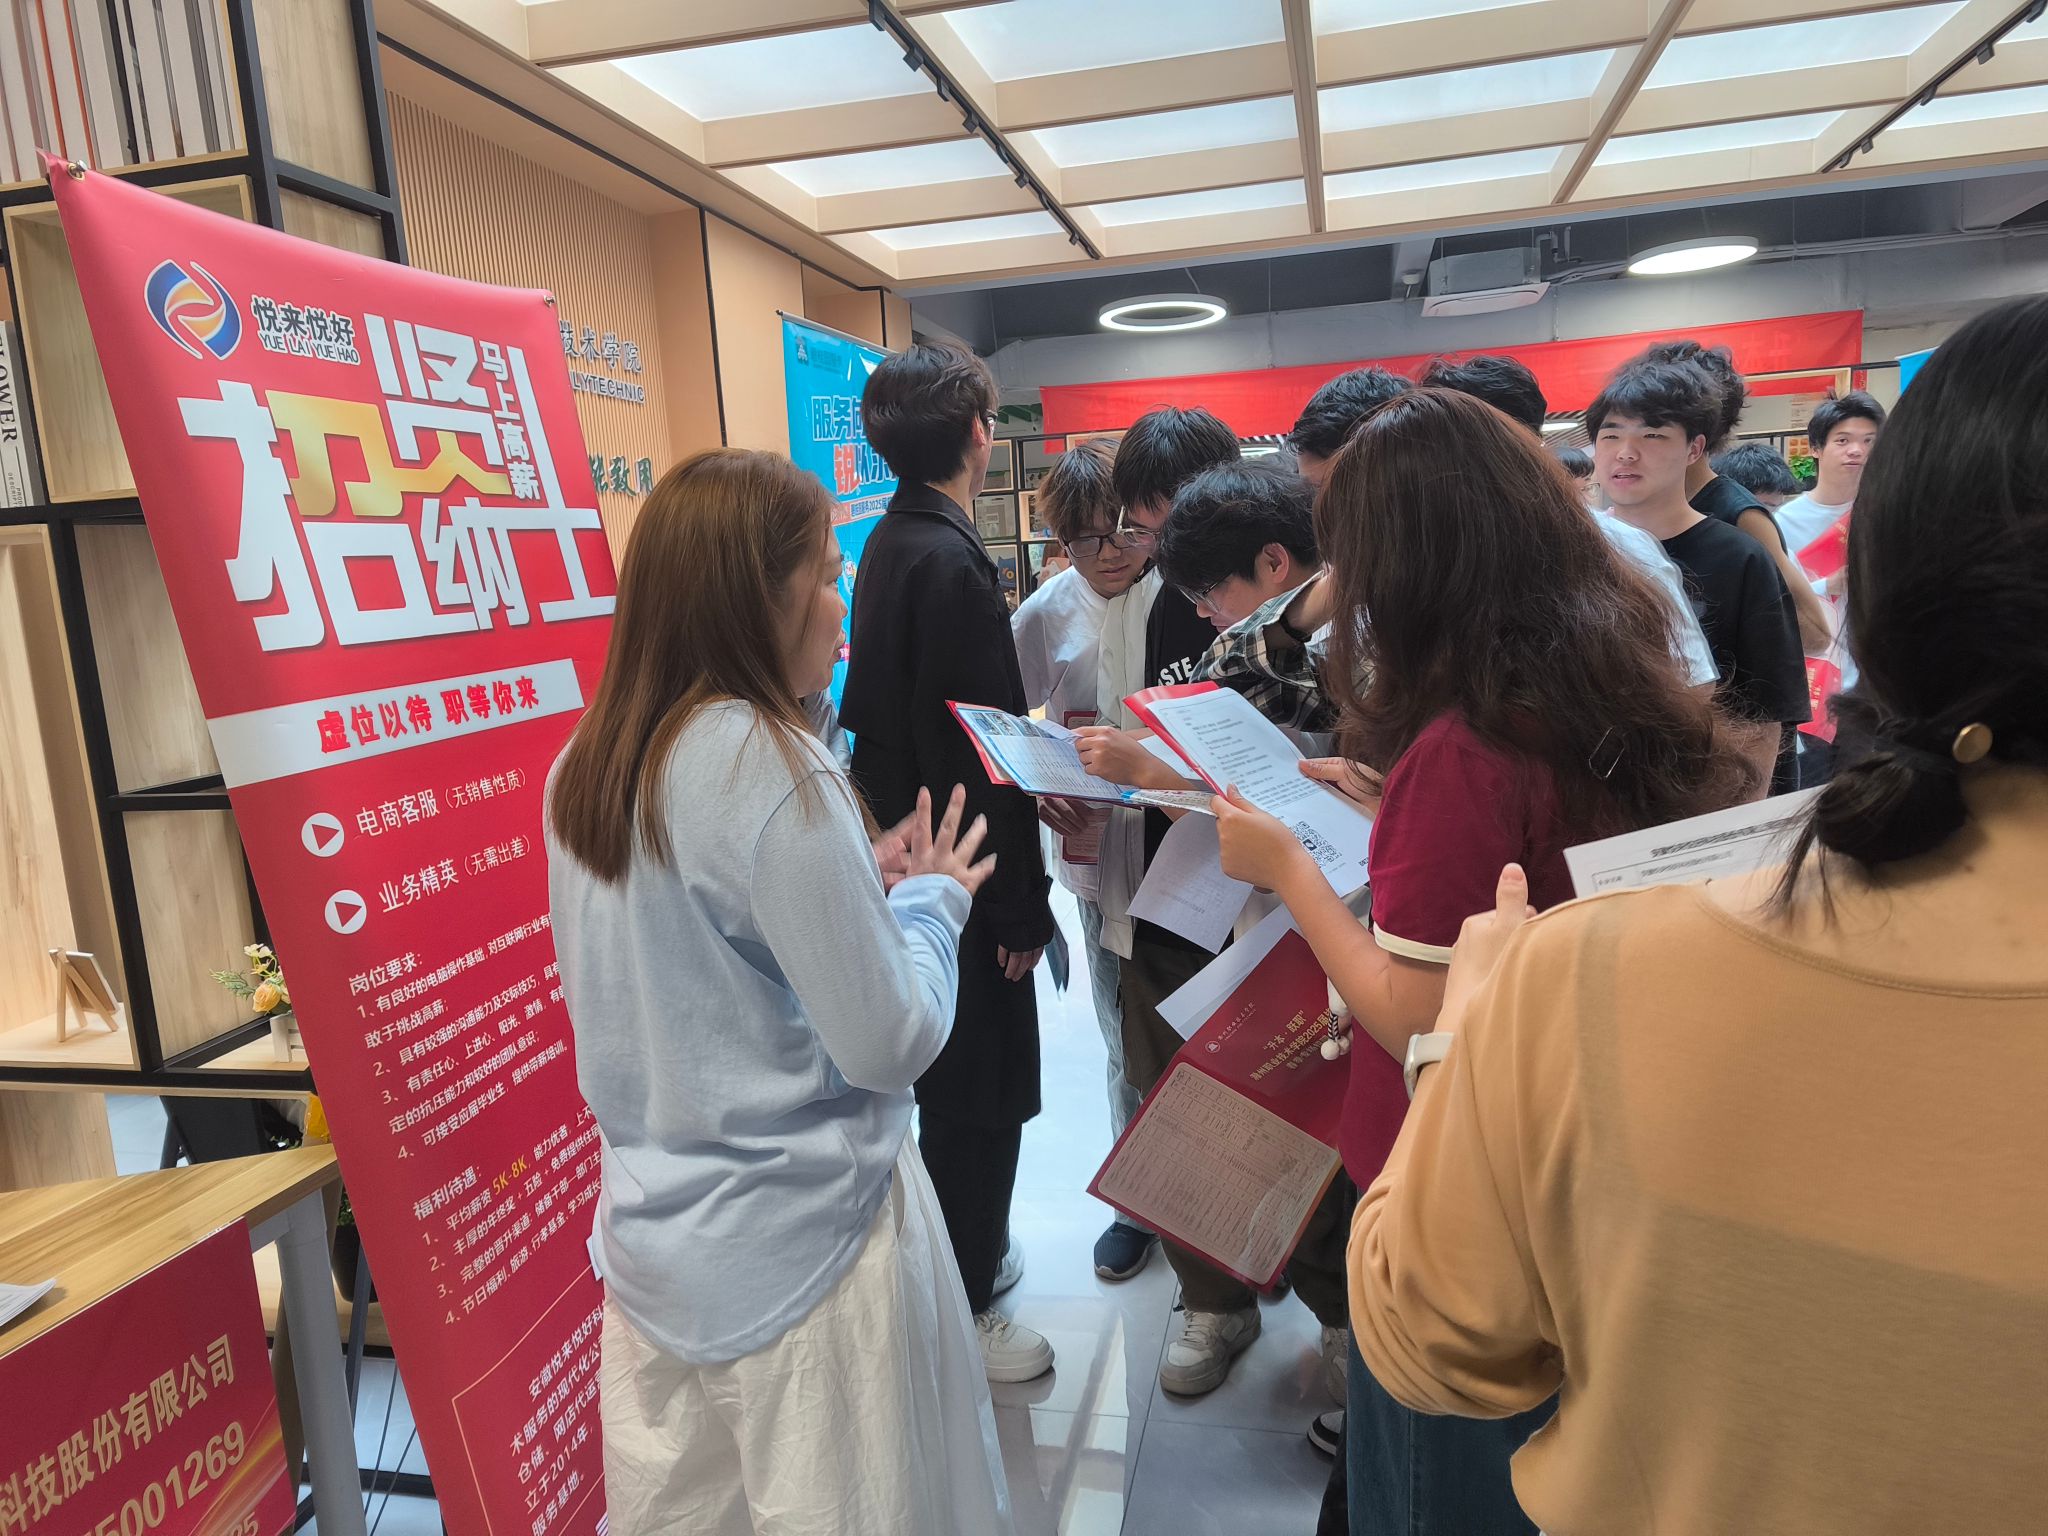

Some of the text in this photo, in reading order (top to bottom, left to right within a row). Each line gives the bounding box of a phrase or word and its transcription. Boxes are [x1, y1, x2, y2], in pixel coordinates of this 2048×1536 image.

[252, 297, 354, 346] 悦来悦好
[260, 333, 359, 363] YUE LAI YUE HAO
[0, 335, 18, 443] OWER
[479, 340, 541, 500] 马上高薪
[316, 675, 540, 753] 虚位以待 职等你来
[349, 952, 424, 996] 岗位要求：
[357, 912, 552, 1019] 1、有良好的电脑操作基础，对互联网行业有
[412, 1165, 482, 1221] 福利待遇：
[528, 1299, 605, 1402] 安徽悦来悦好科
[0, 1334, 236, 1534] 科技股份有限公司
[84, 1420, 246, 1536] 001269
